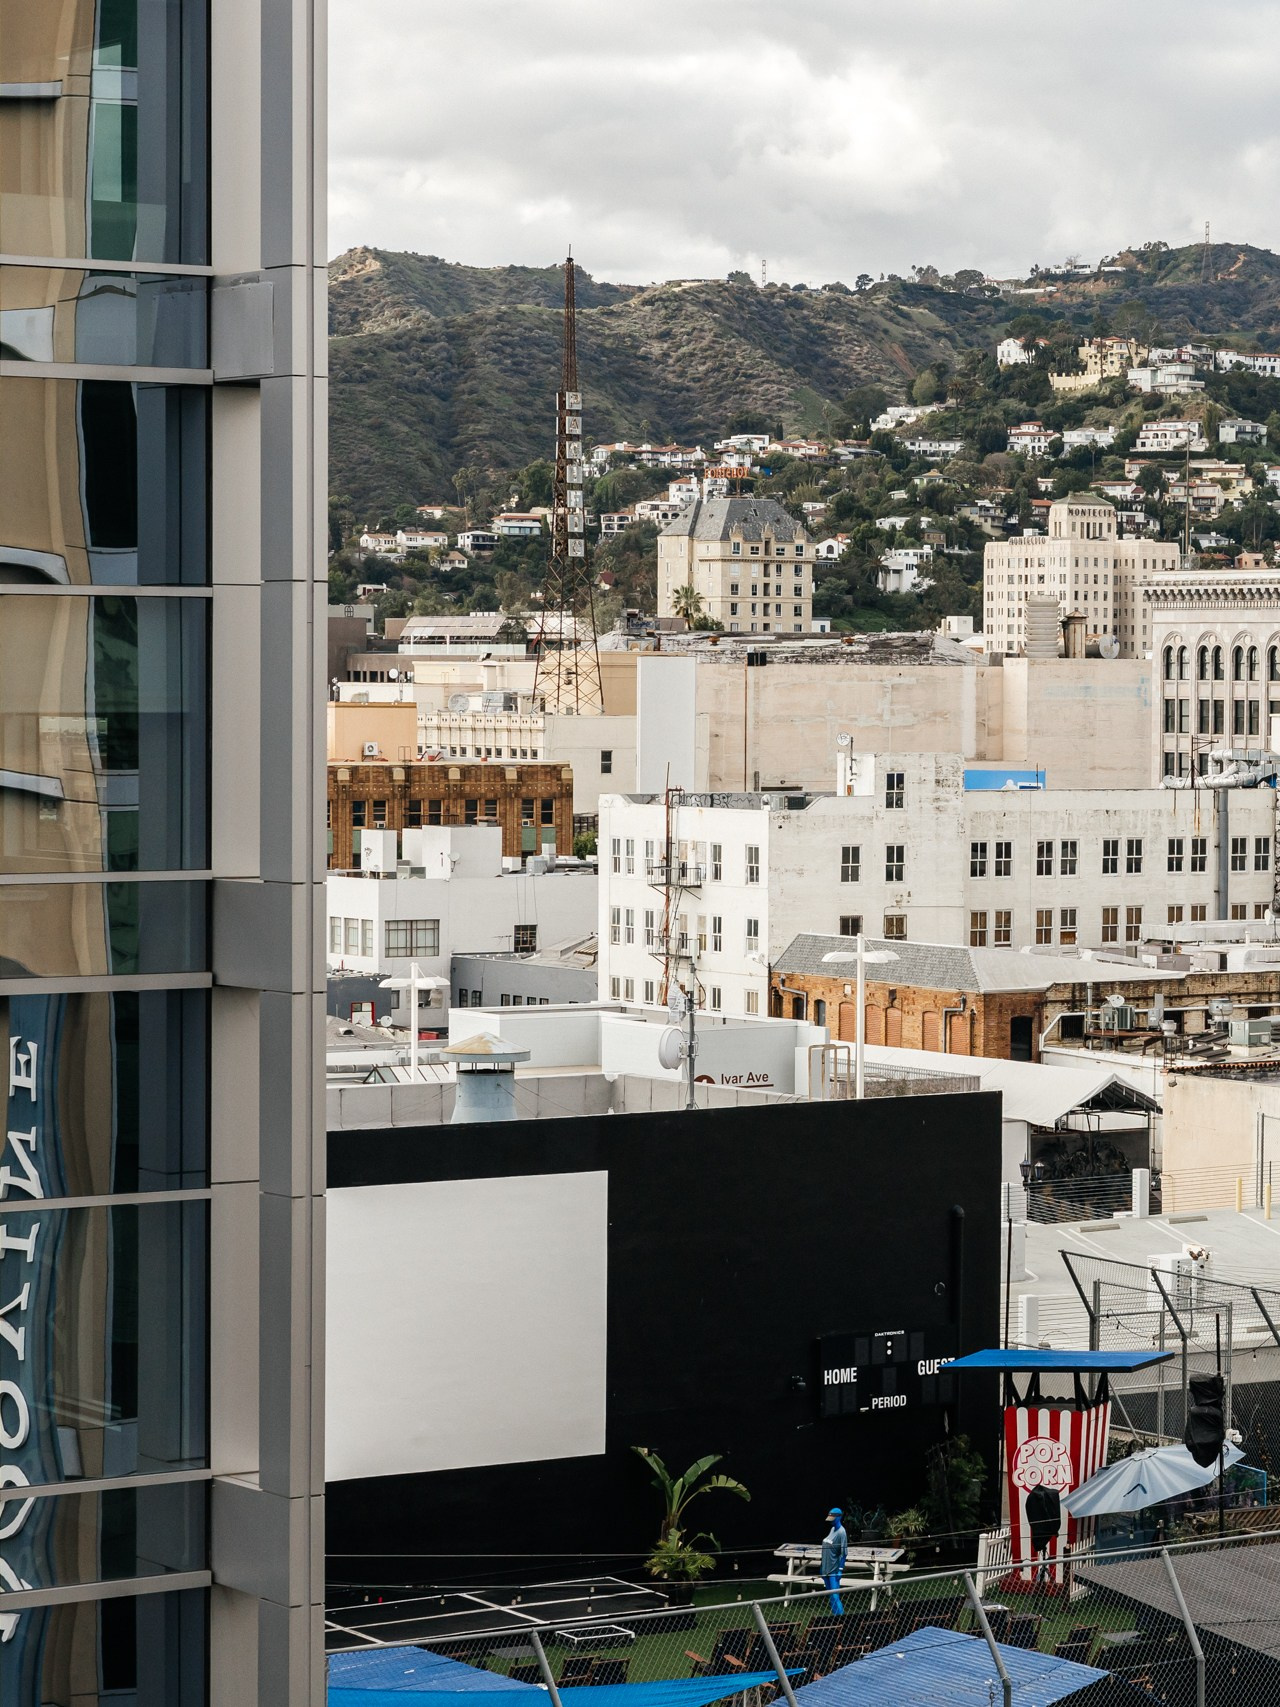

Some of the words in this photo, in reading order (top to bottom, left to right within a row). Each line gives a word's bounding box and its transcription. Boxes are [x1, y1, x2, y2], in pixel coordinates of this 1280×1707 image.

[1068, 508, 1117, 517] MONTECITO
[1009, 537, 1046, 545] MONTECITO
[721, 1074, 743, 1085] Ivar
[746, 1072, 769, 1083] Ave
[824, 1367, 857, 1385] HOME
[872, 1395, 907, 1409] PERIOD
[1020, 1443, 1066, 1464] POP
[1012, 1465, 1074, 1487] CORN
